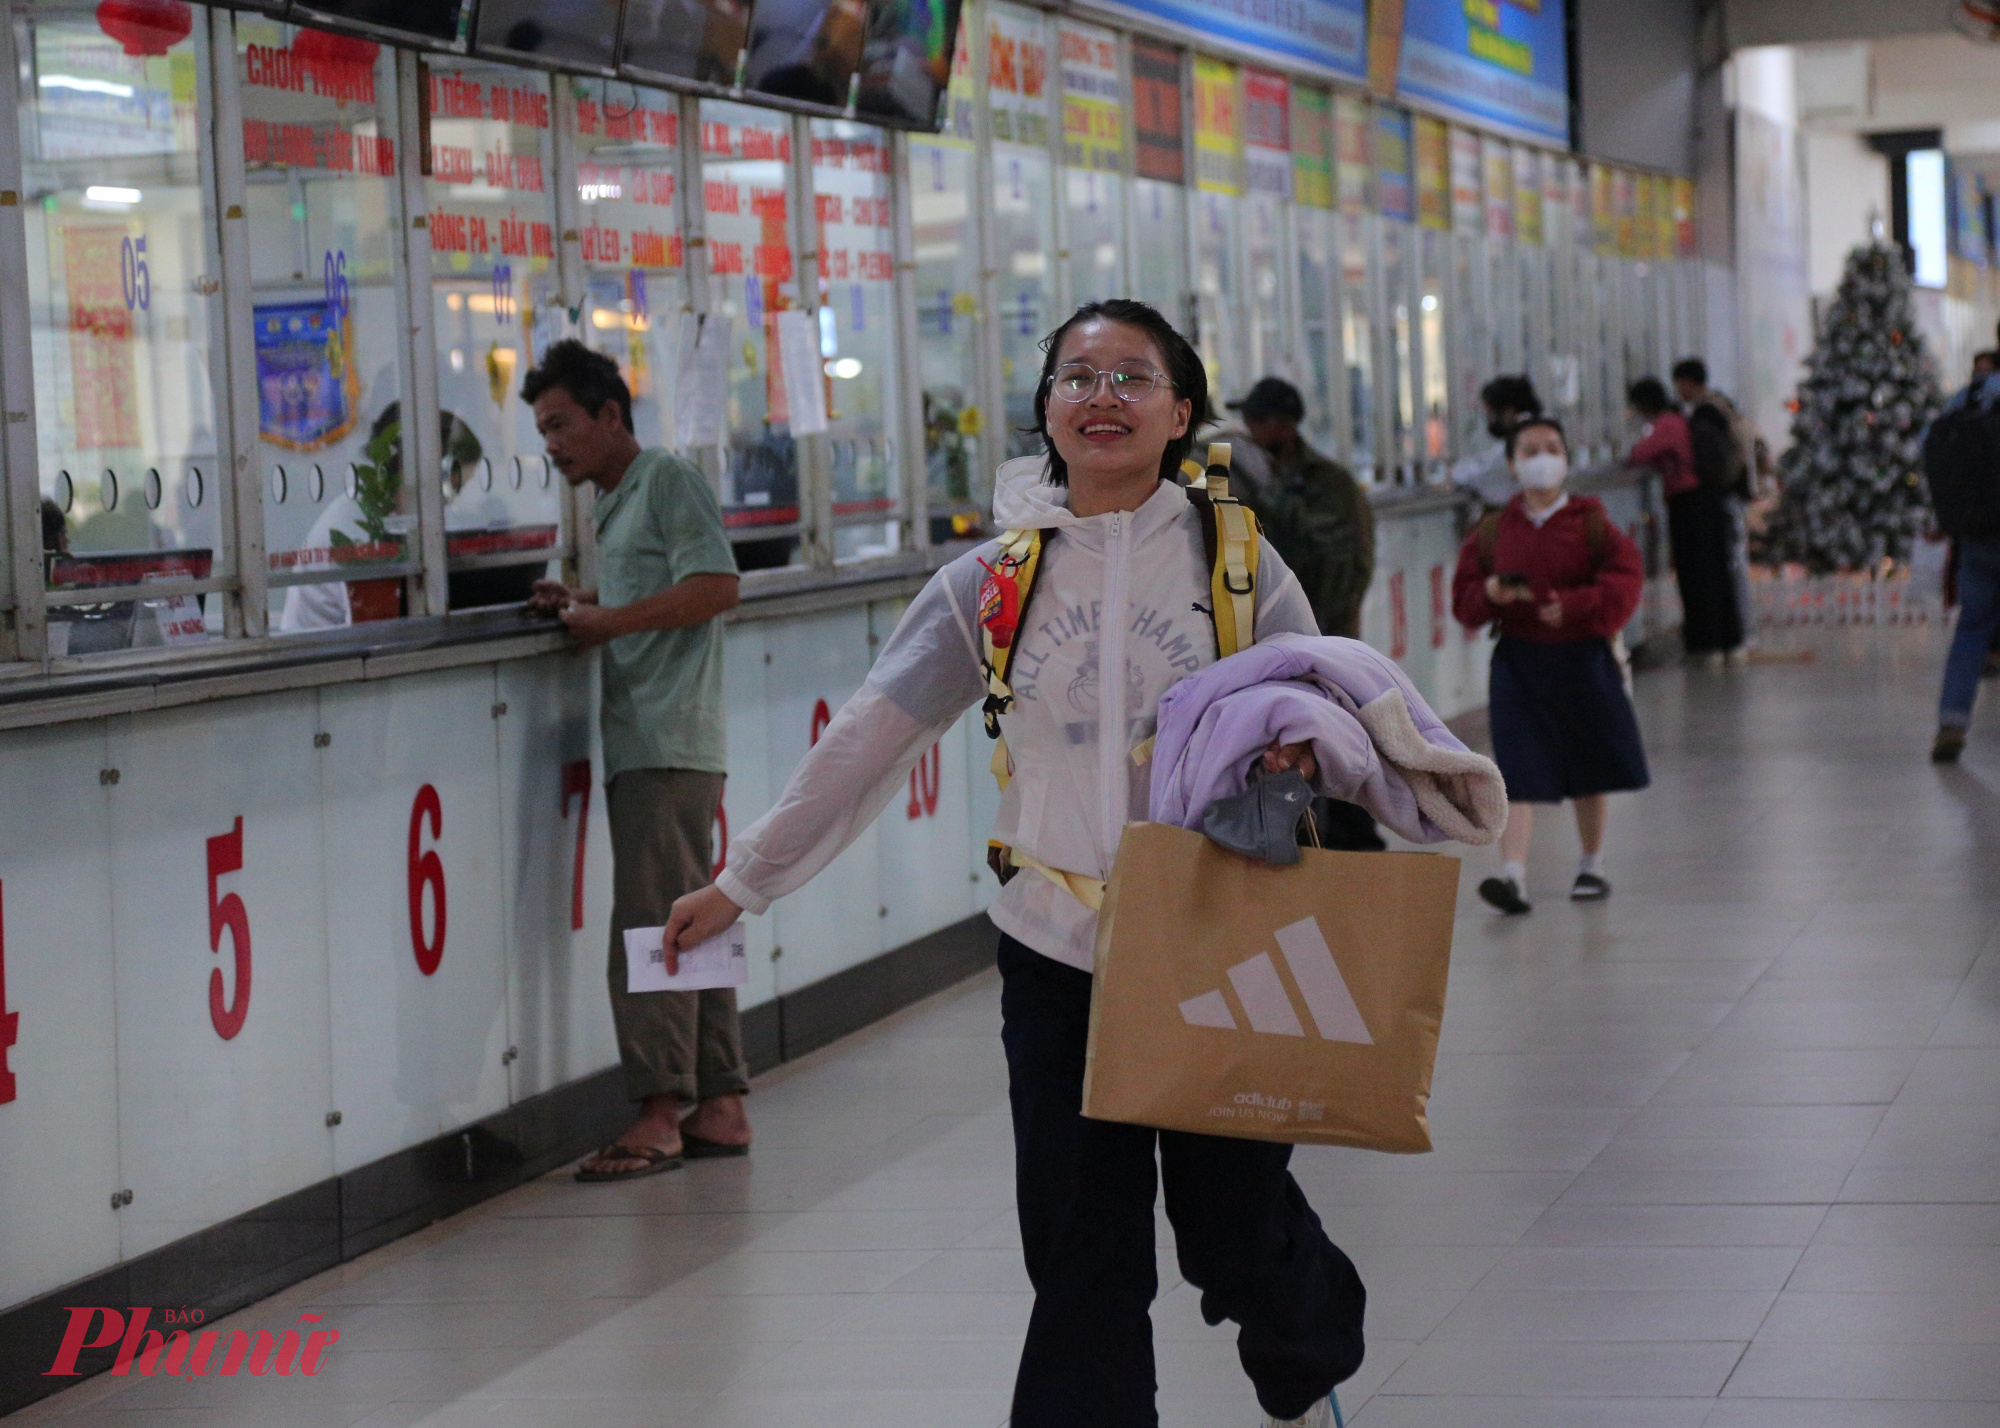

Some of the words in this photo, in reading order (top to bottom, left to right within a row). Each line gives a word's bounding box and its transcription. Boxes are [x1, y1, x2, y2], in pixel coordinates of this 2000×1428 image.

[432, 145, 473, 184] LEIKU
[469, 216, 488, 253] PA
[121, 234, 150, 310] 05
[325, 249, 348, 317] 06
[1014, 647, 1050, 702] ALL
[1130, 601, 1200, 682] HAMP
[407, 783, 447, 977] 6
[561, 758, 592, 931] 7
[206, 814, 252, 1041] 5
[1209, 1107, 1235, 1117] JOIN
[1239, 1108, 1254, 1118] US
[1258, 1110, 1288, 1122] NOW
[1234, 1092, 1292, 1110] adiclub
